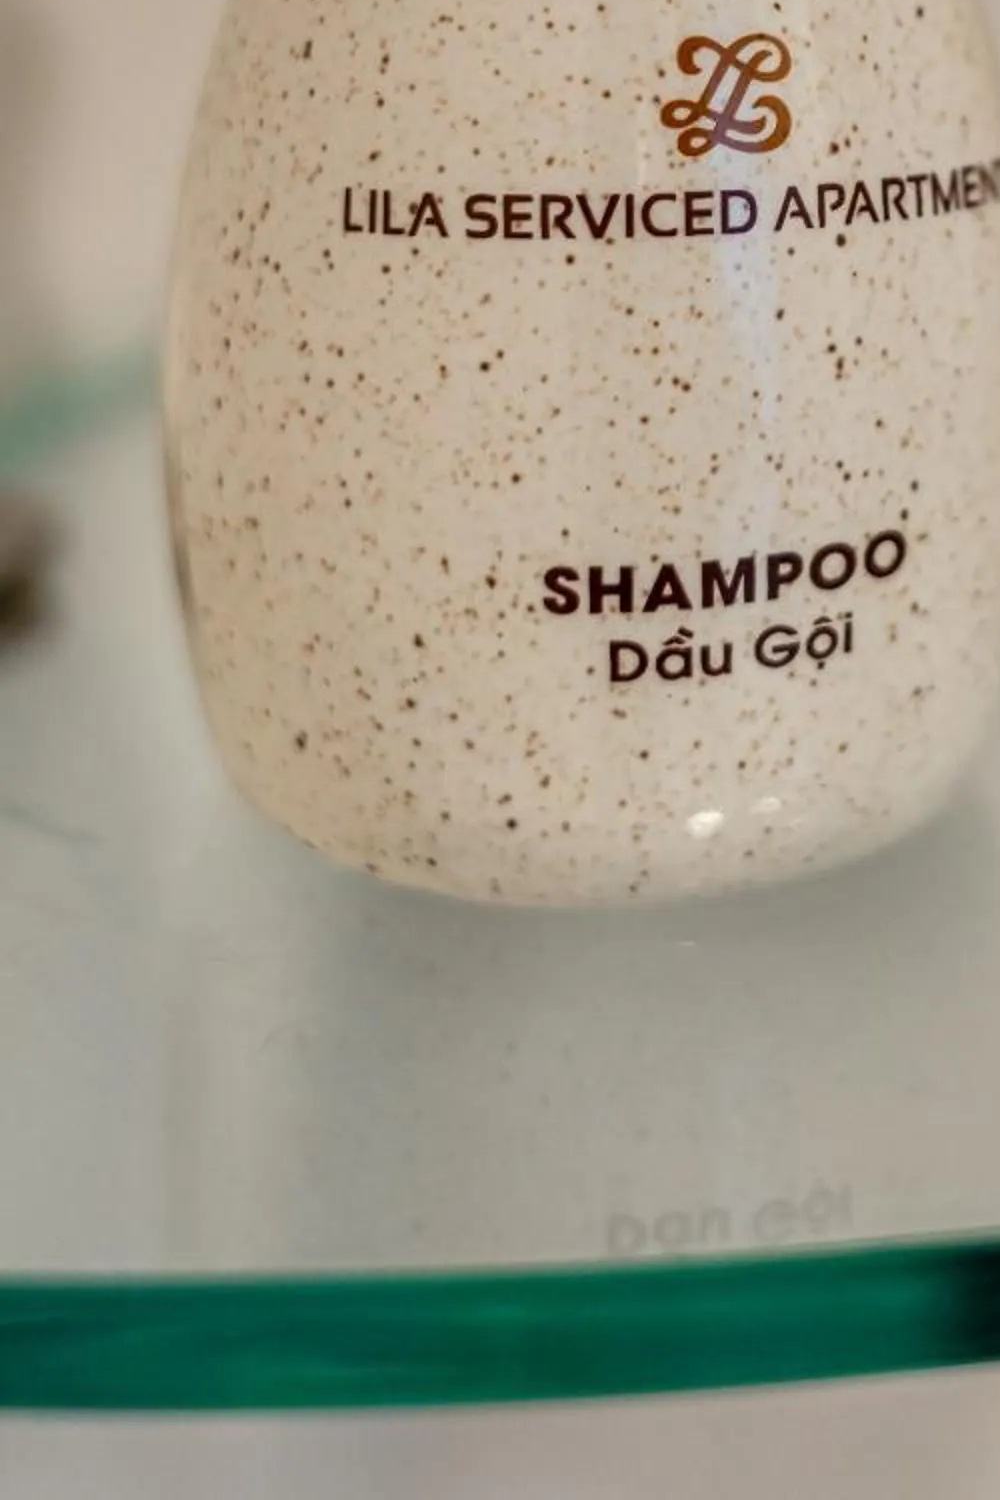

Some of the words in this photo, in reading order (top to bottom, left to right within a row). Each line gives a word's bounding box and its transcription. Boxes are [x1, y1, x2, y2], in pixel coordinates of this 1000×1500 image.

[342, 187, 449, 241] LILA
[464, 189, 758, 241] SERVICED
[542, 530, 907, 615] SHAMPOO
[609, 627, 733, 683] Dầu
[754, 611, 854, 670] Gội
